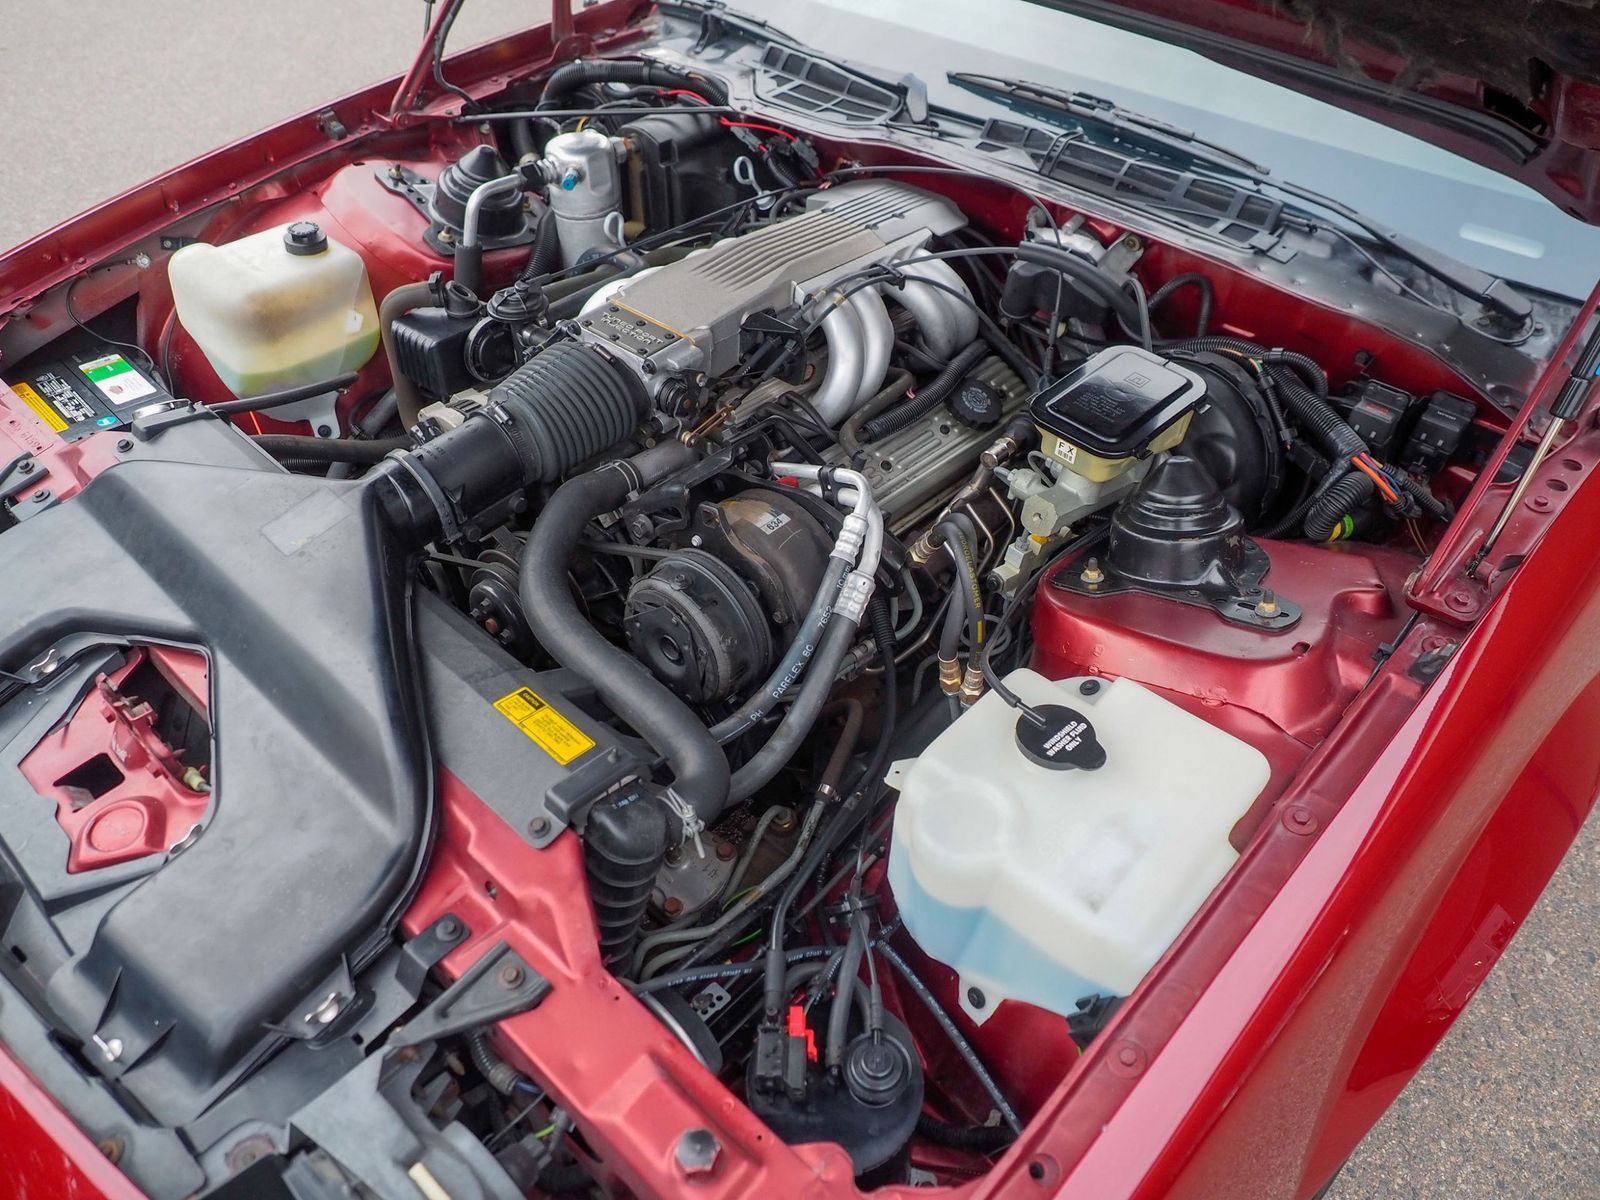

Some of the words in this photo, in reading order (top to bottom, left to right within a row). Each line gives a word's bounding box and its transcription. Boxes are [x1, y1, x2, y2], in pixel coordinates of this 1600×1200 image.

[635, 329, 663, 344] PORT
[767, 518, 783, 531] 634
[959, 531, 981, 609] UOROELASTOMER
[750, 709, 764, 721] PH
[772, 661, 805, 699] PARFLEX
[802, 644, 814, 658] 80
[817, 605, 834, 629] 7652
[1043, 720, 1077, 749] WINDSHIELD
[1046, 735, 1072, 756] WASHER
[1069, 722, 1087, 737] FLUID
[1065, 736, 1082, 751] ONLY
